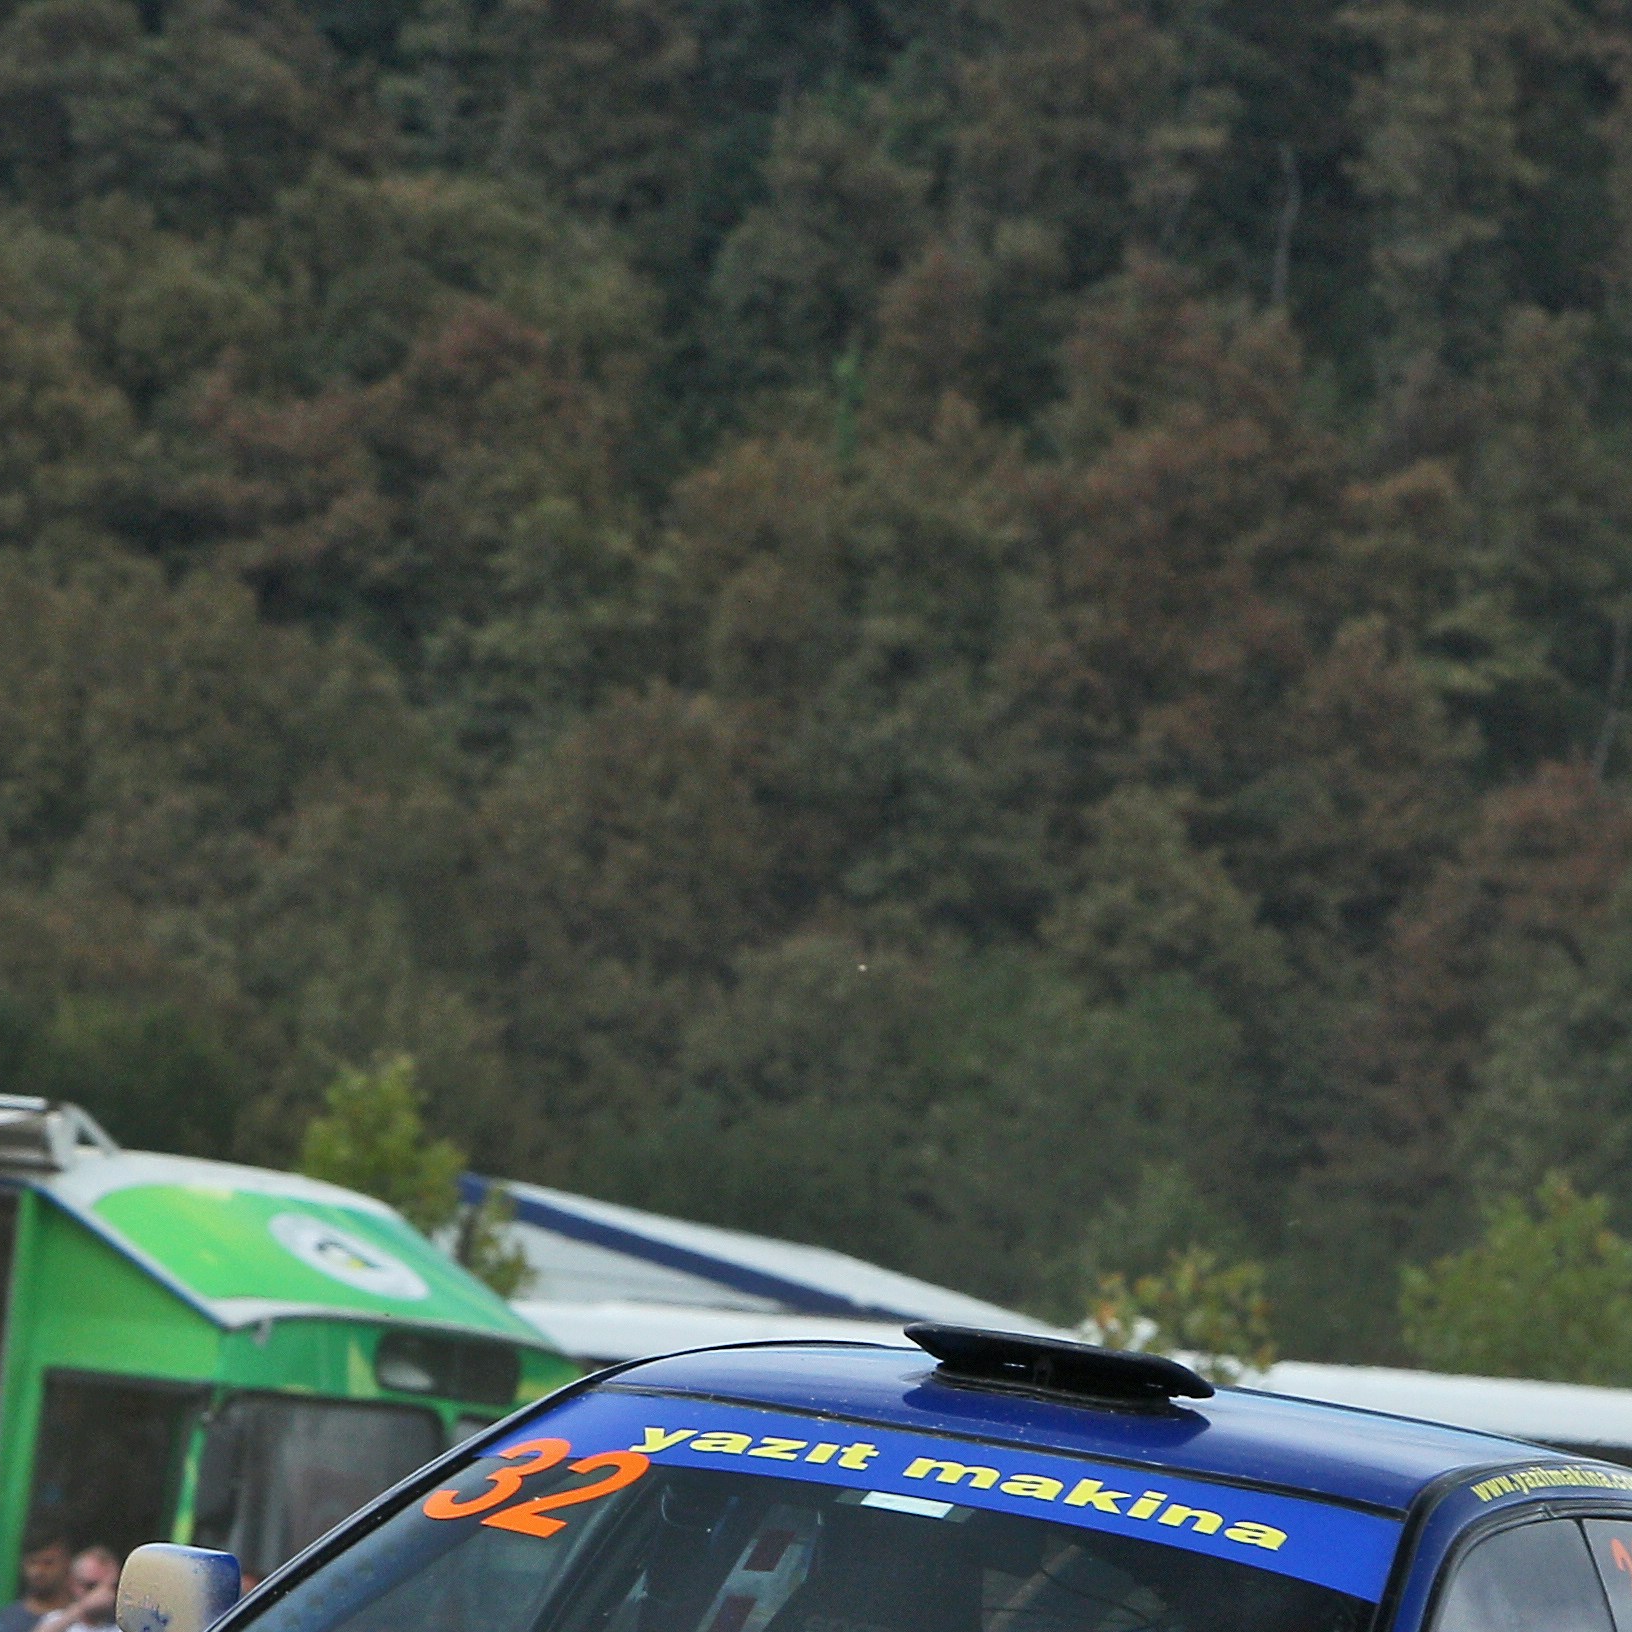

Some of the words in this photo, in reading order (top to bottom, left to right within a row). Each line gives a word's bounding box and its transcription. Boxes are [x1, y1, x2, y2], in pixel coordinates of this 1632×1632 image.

[423, 1437, 651, 1539] 32
[629, 1426, 880, 1472] yazıt
[902, 1456, 1289, 1552] makina
